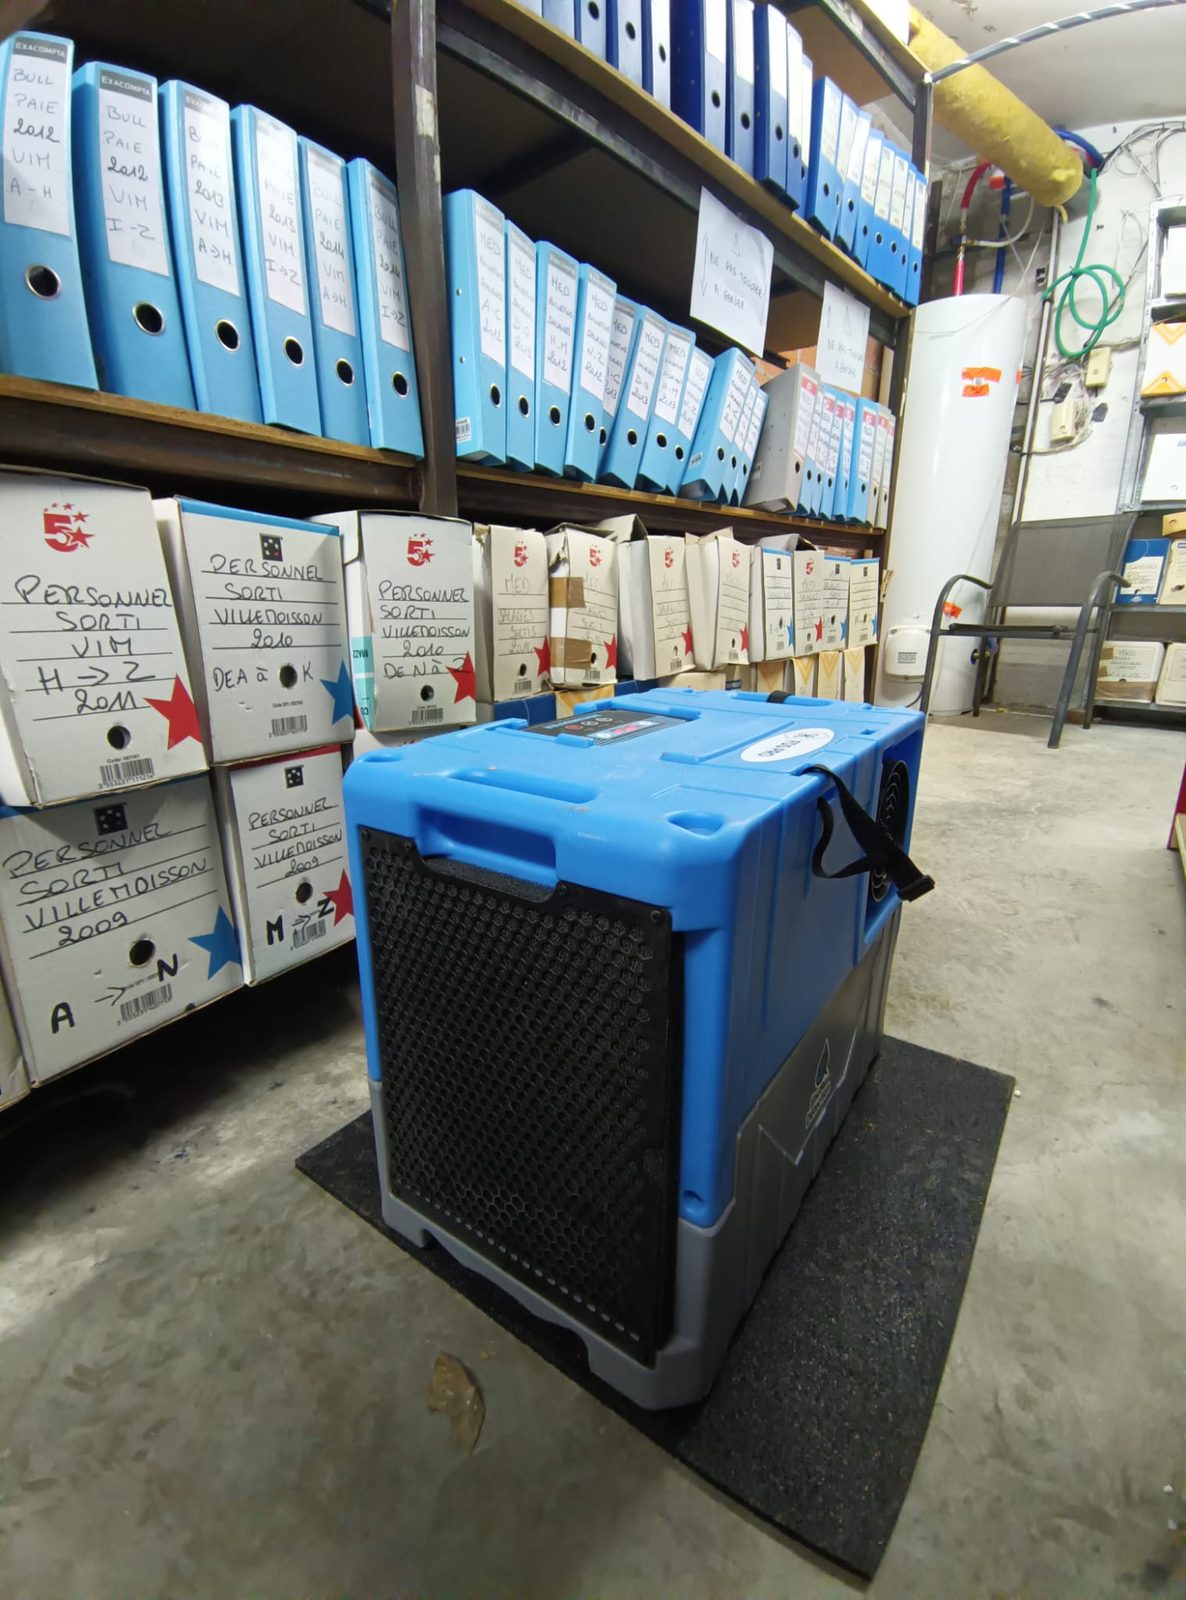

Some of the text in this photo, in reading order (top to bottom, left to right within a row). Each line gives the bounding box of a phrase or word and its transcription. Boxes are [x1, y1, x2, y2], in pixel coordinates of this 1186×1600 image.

[13, 68, 53, 85] BULL
[15, 93, 58, 113] PAIE
[106, 105, 146, 128] BULL
[14, 119, 60, 143] 2012
[104, 131, 142, 153] PAIE
[12, 151, 50, 169] VIM
[107, 156, 148, 181] 2012
[109, 186, 148, 210] VIM
[195, 209, 229, 236] VIM
[210, 553, 324, 580] PERSONNEL
[15, 575, 172, 608] PERSONNEL
[224, 582, 283, 600] SORTI
[378, 580, 470, 602] PERSONNEL
[56, 611, 141, 631] SORTI
[214, 608, 322, 624] VILLEMOISSON
[380, 605, 435, 620] SORTI
[72, 636, 132, 658] VIM
[250, 628, 293, 648] 2010
[402, 639, 444, 657] 2010
[213, 667, 248, 692] DEA
[303, 660, 314, 682] K
[413, 662, 427, 676] N
[74, 688, 137, 714] 2011
[248, 797, 339, 830] PERSONNEL
[268, 823, 316, 843] SORTI
[2, 823, 171, 878] PERSONNEL
[285, 855, 319, 878] 2009
[20, 863, 124, 904] SORTI
[25, 858, 206, 930] VILLEMOISSON
[58, 911, 128, 946] 2009
[266, 897, 334, 945] M Z
[50, 1002, 75, 1034] A
[157, 954, 178, 981] N
